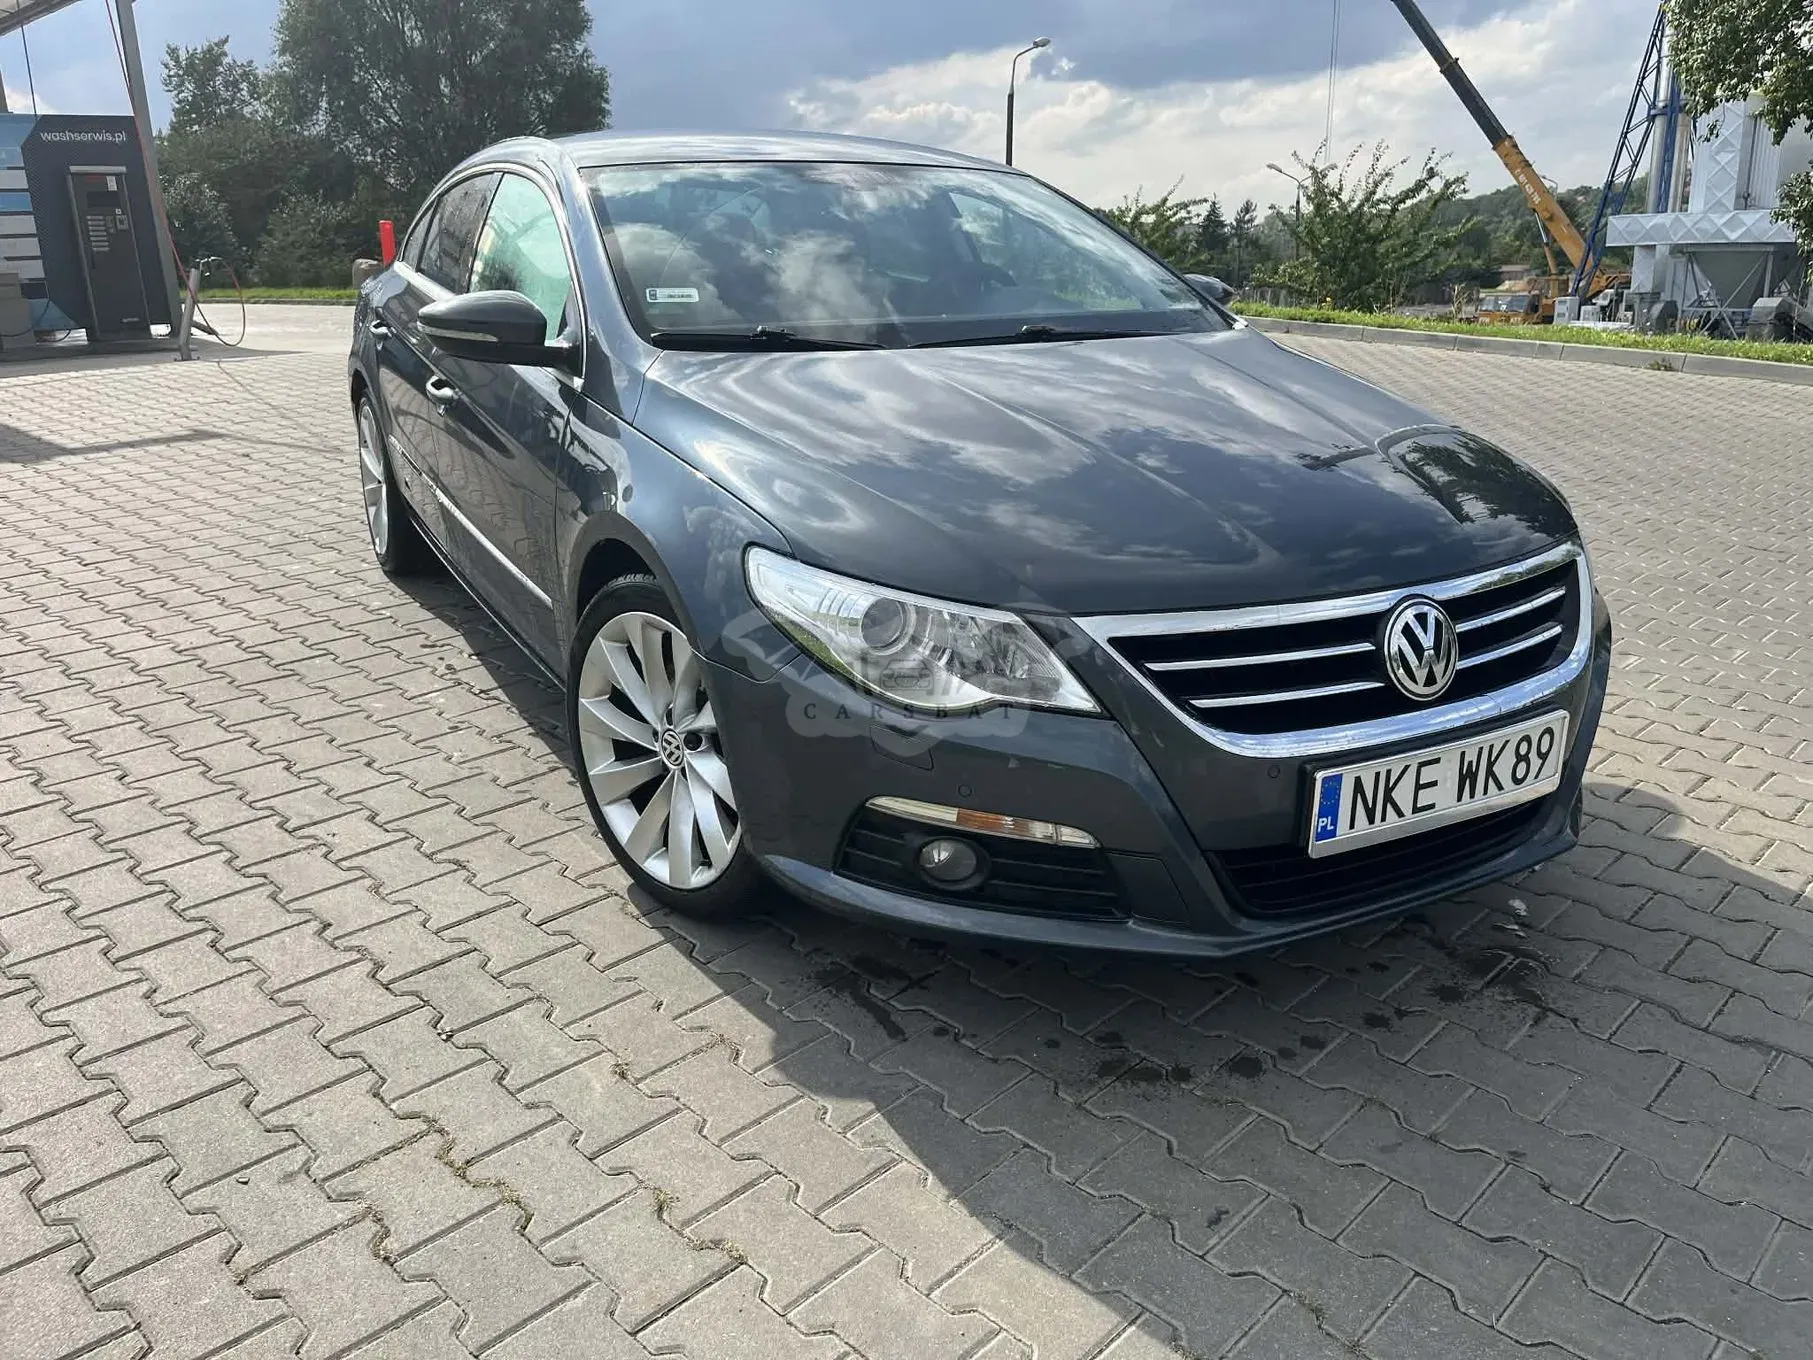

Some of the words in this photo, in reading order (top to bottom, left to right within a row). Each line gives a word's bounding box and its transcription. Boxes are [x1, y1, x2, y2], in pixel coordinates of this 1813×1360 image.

[40, 130, 126, 143] washserwis.pl
[1349, 757, 1441, 830] NKE
[1456, 726, 1555, 802] WK89
[1317, 817, 1334, 832] PL
